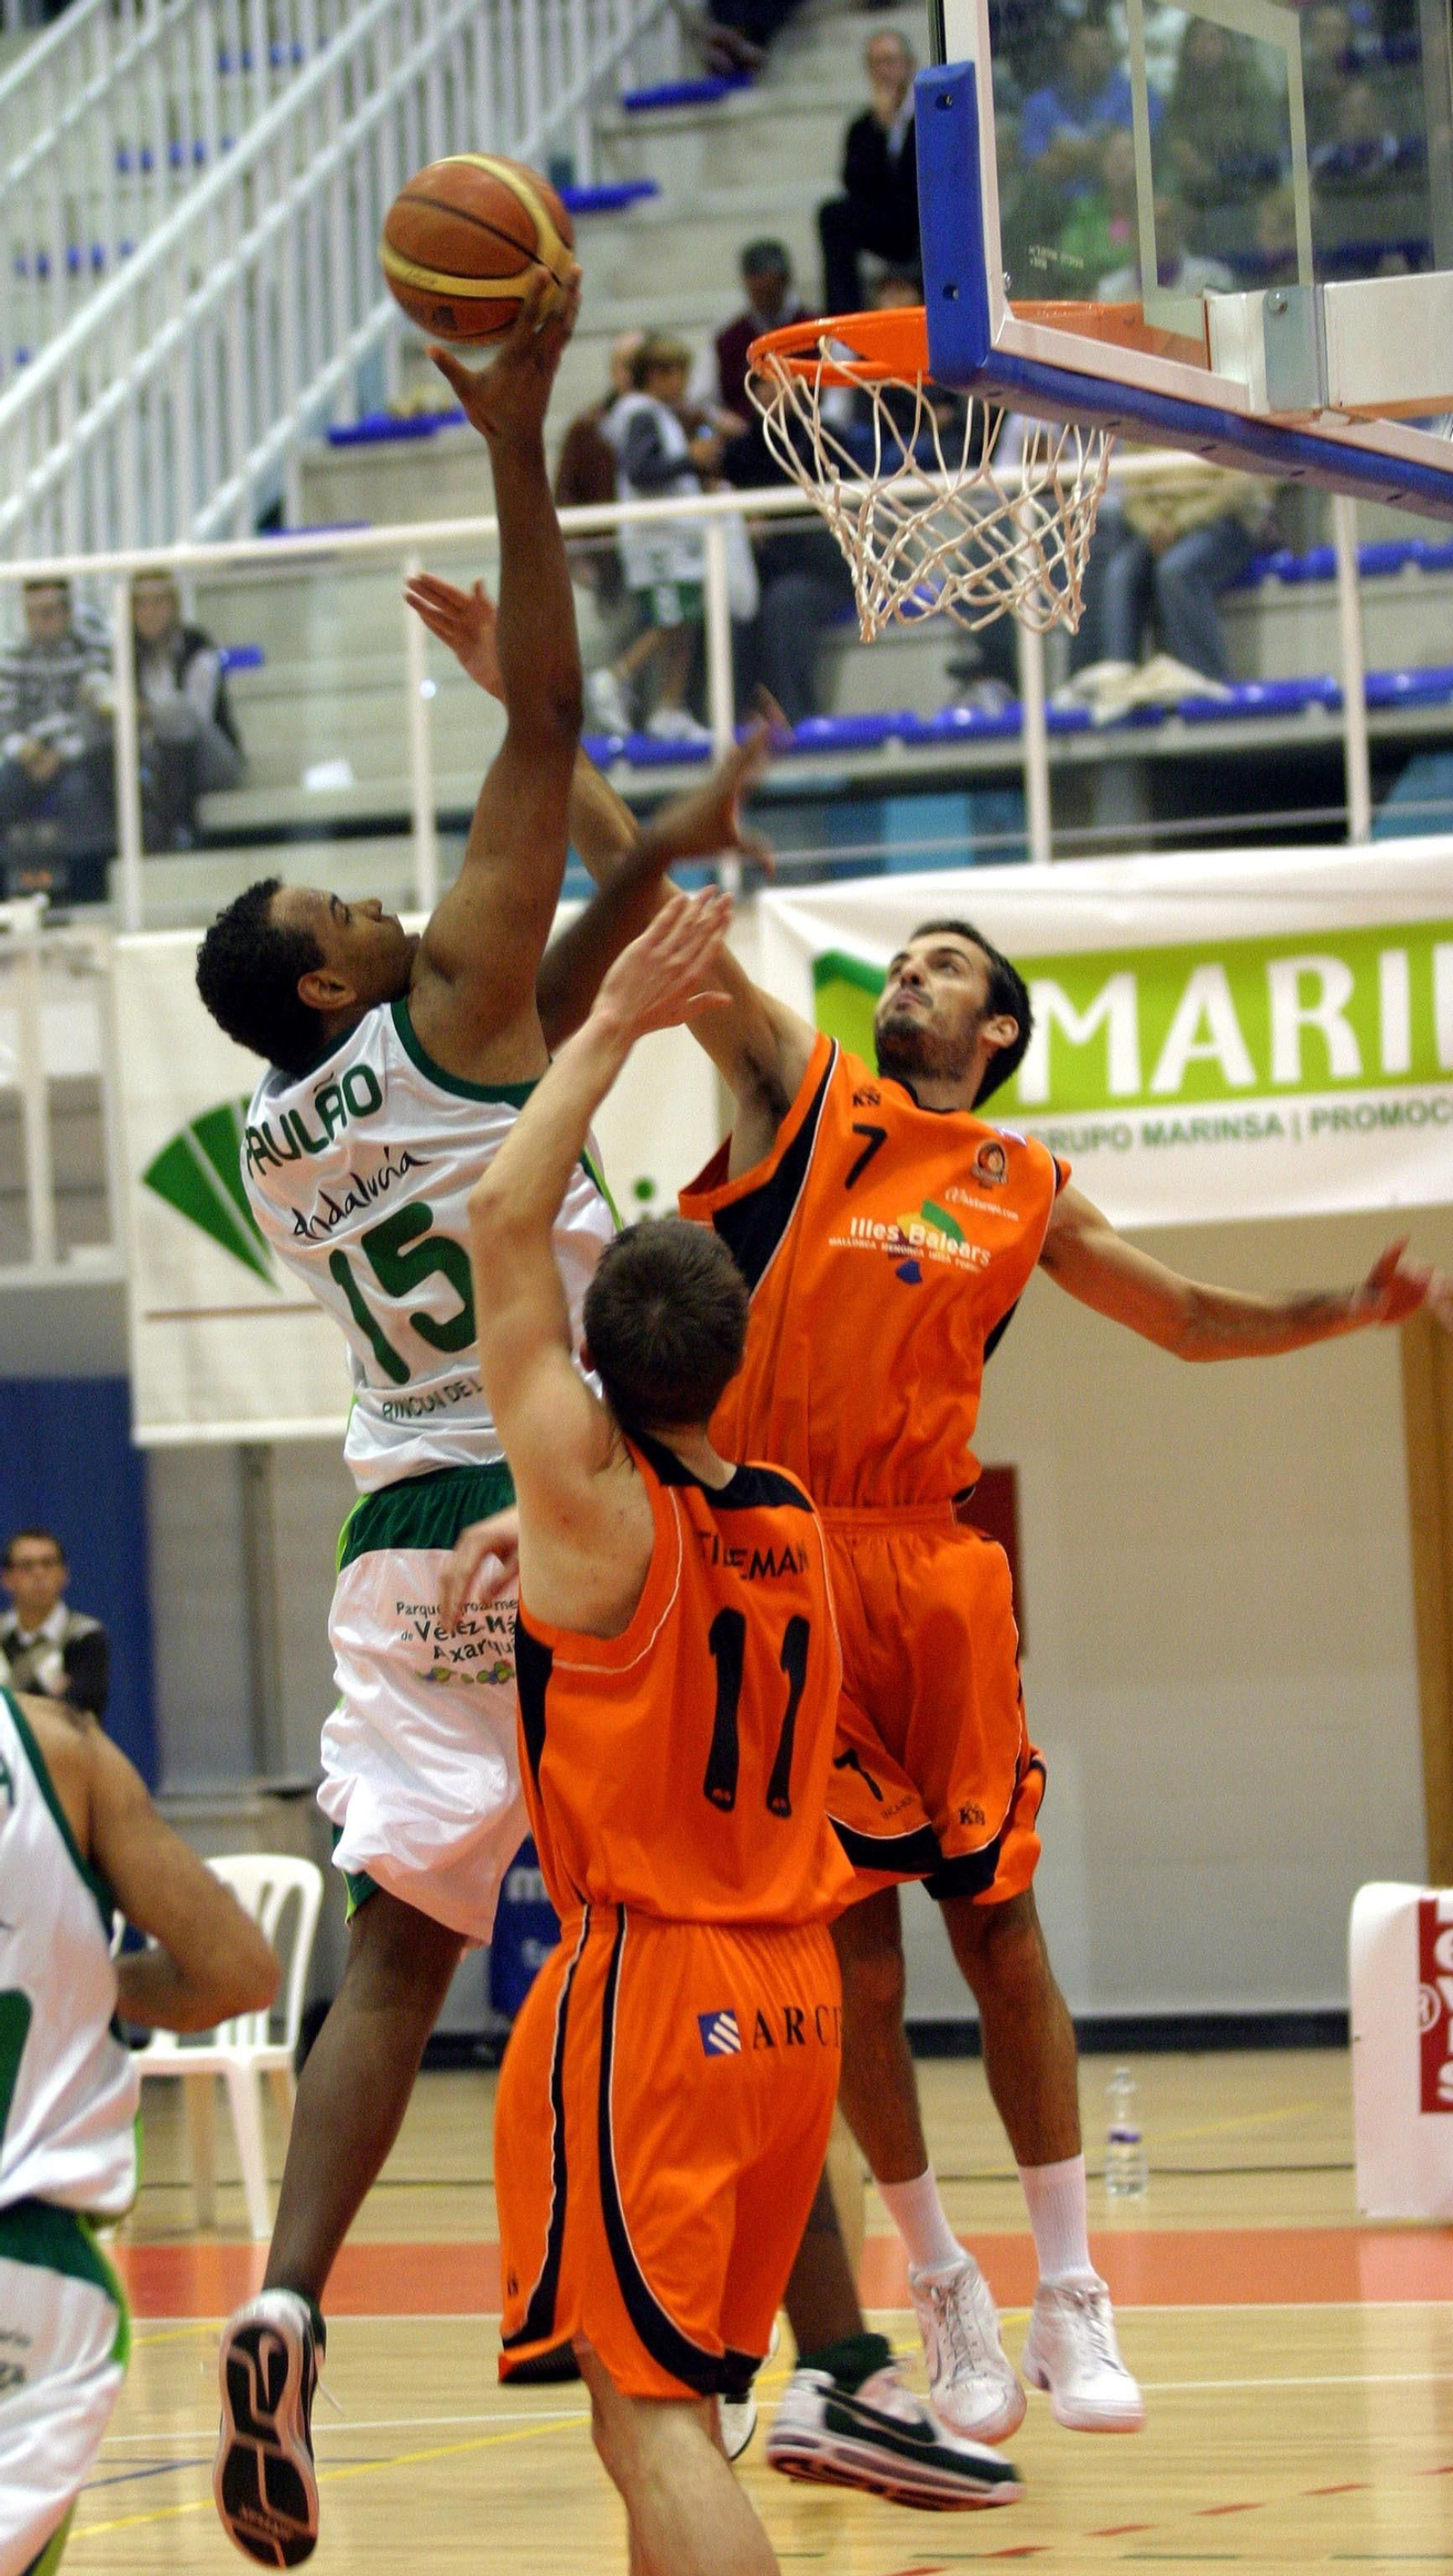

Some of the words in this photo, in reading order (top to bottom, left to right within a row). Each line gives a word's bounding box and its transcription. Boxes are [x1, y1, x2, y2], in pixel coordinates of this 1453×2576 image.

[1017, 942, 1453, 1105] MARI
[845, 1123, 888, 1190] 7
[1141, 1110, 1285, 1146] MARINSA
[329, 1201, 478, 1384] 15
[850, 1216, 900, 1242] Illes
[909, 1223, 992, 1267] Balears
[703, 1606, 811, 1818] 11
